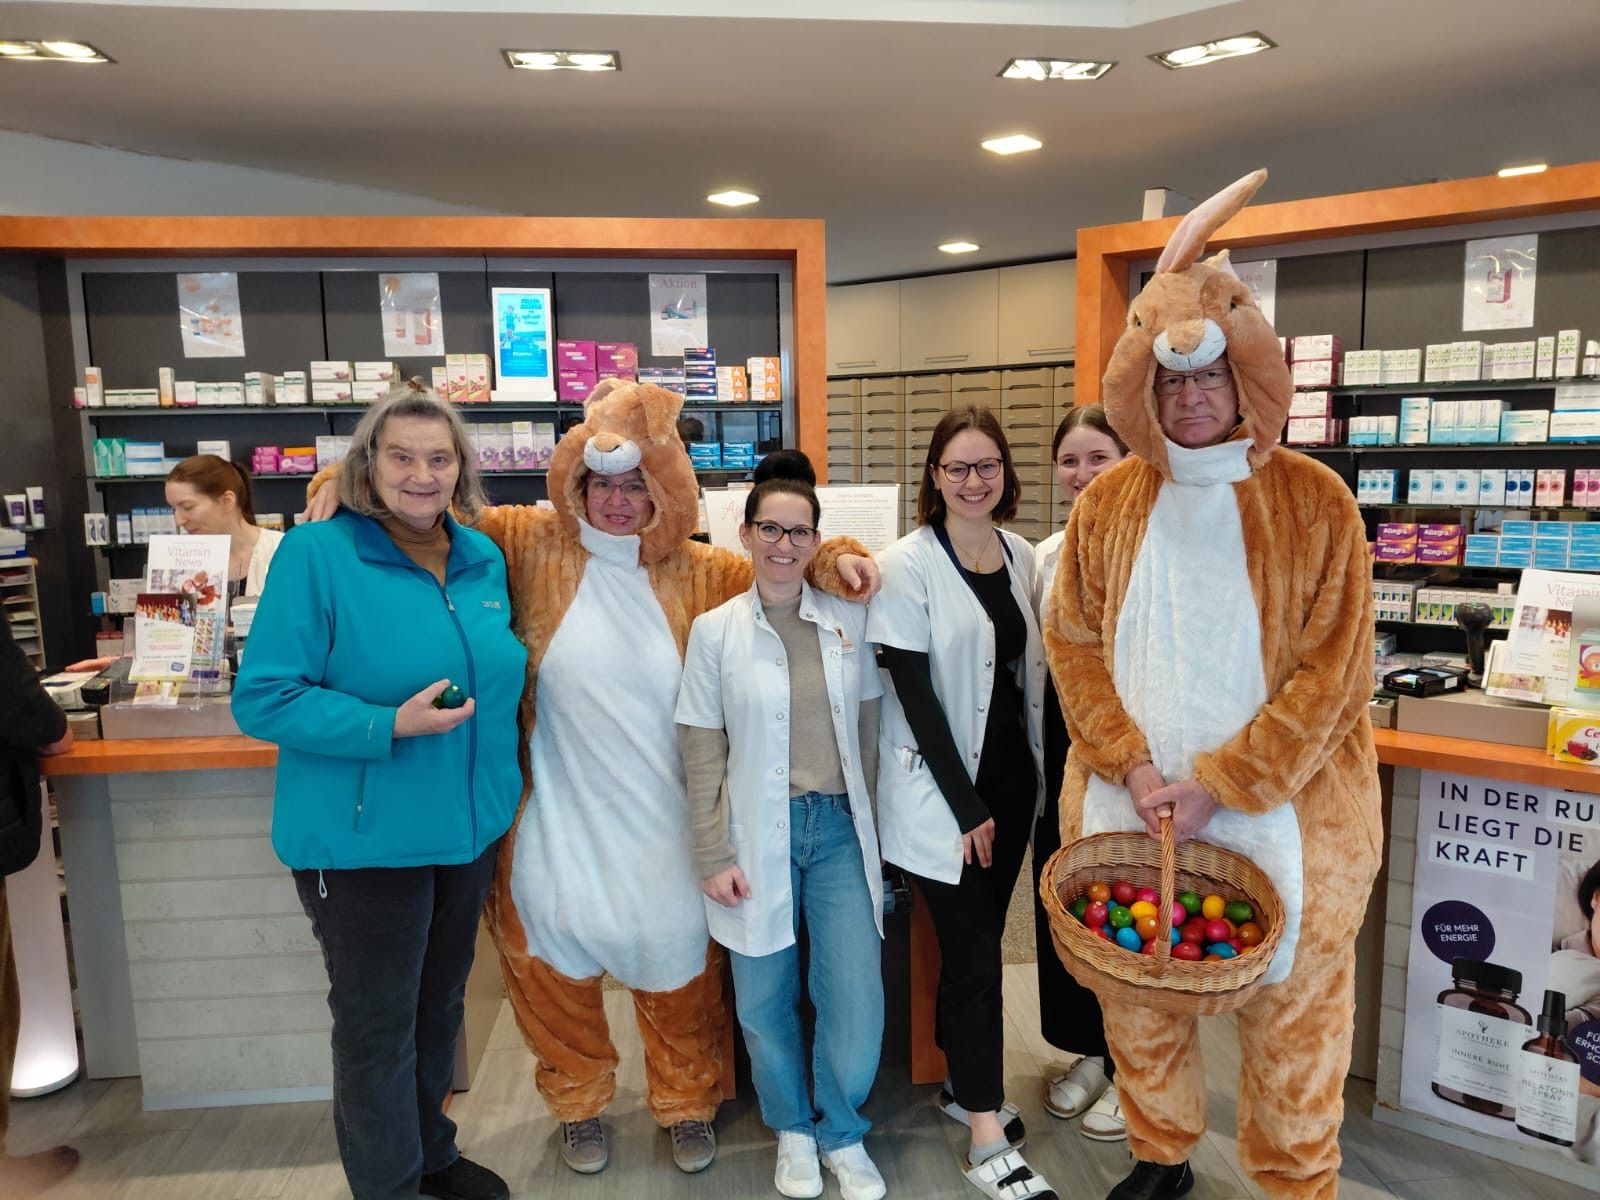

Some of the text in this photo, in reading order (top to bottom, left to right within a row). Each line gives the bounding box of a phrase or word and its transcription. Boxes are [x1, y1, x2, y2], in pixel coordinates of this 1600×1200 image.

[1383, 527, 1408, 536] Allegra
[1424, 529, 1449, 537] Allegra
[167, 546, 212, 558] Vitamin
[1381, 547, 1406, 555] Allegra
[1422, 548, 1447, 557] Allegra
[1440, 781, 1600, 823] IN DER RU
[1438, 810, 1584, 853] LIEGT DIE
[1436, 840, 1528, 873] KRAFT
[1434, 923, 1480, 933] FÜR MEHR
[1440, 933, 1479, 942] ENERGIE
[1451, 1048, 1483, 1063] INNERE
[1487, 1058, 1510, 1071] RUHE
[1586, 1052, 1600, 1065] SC
